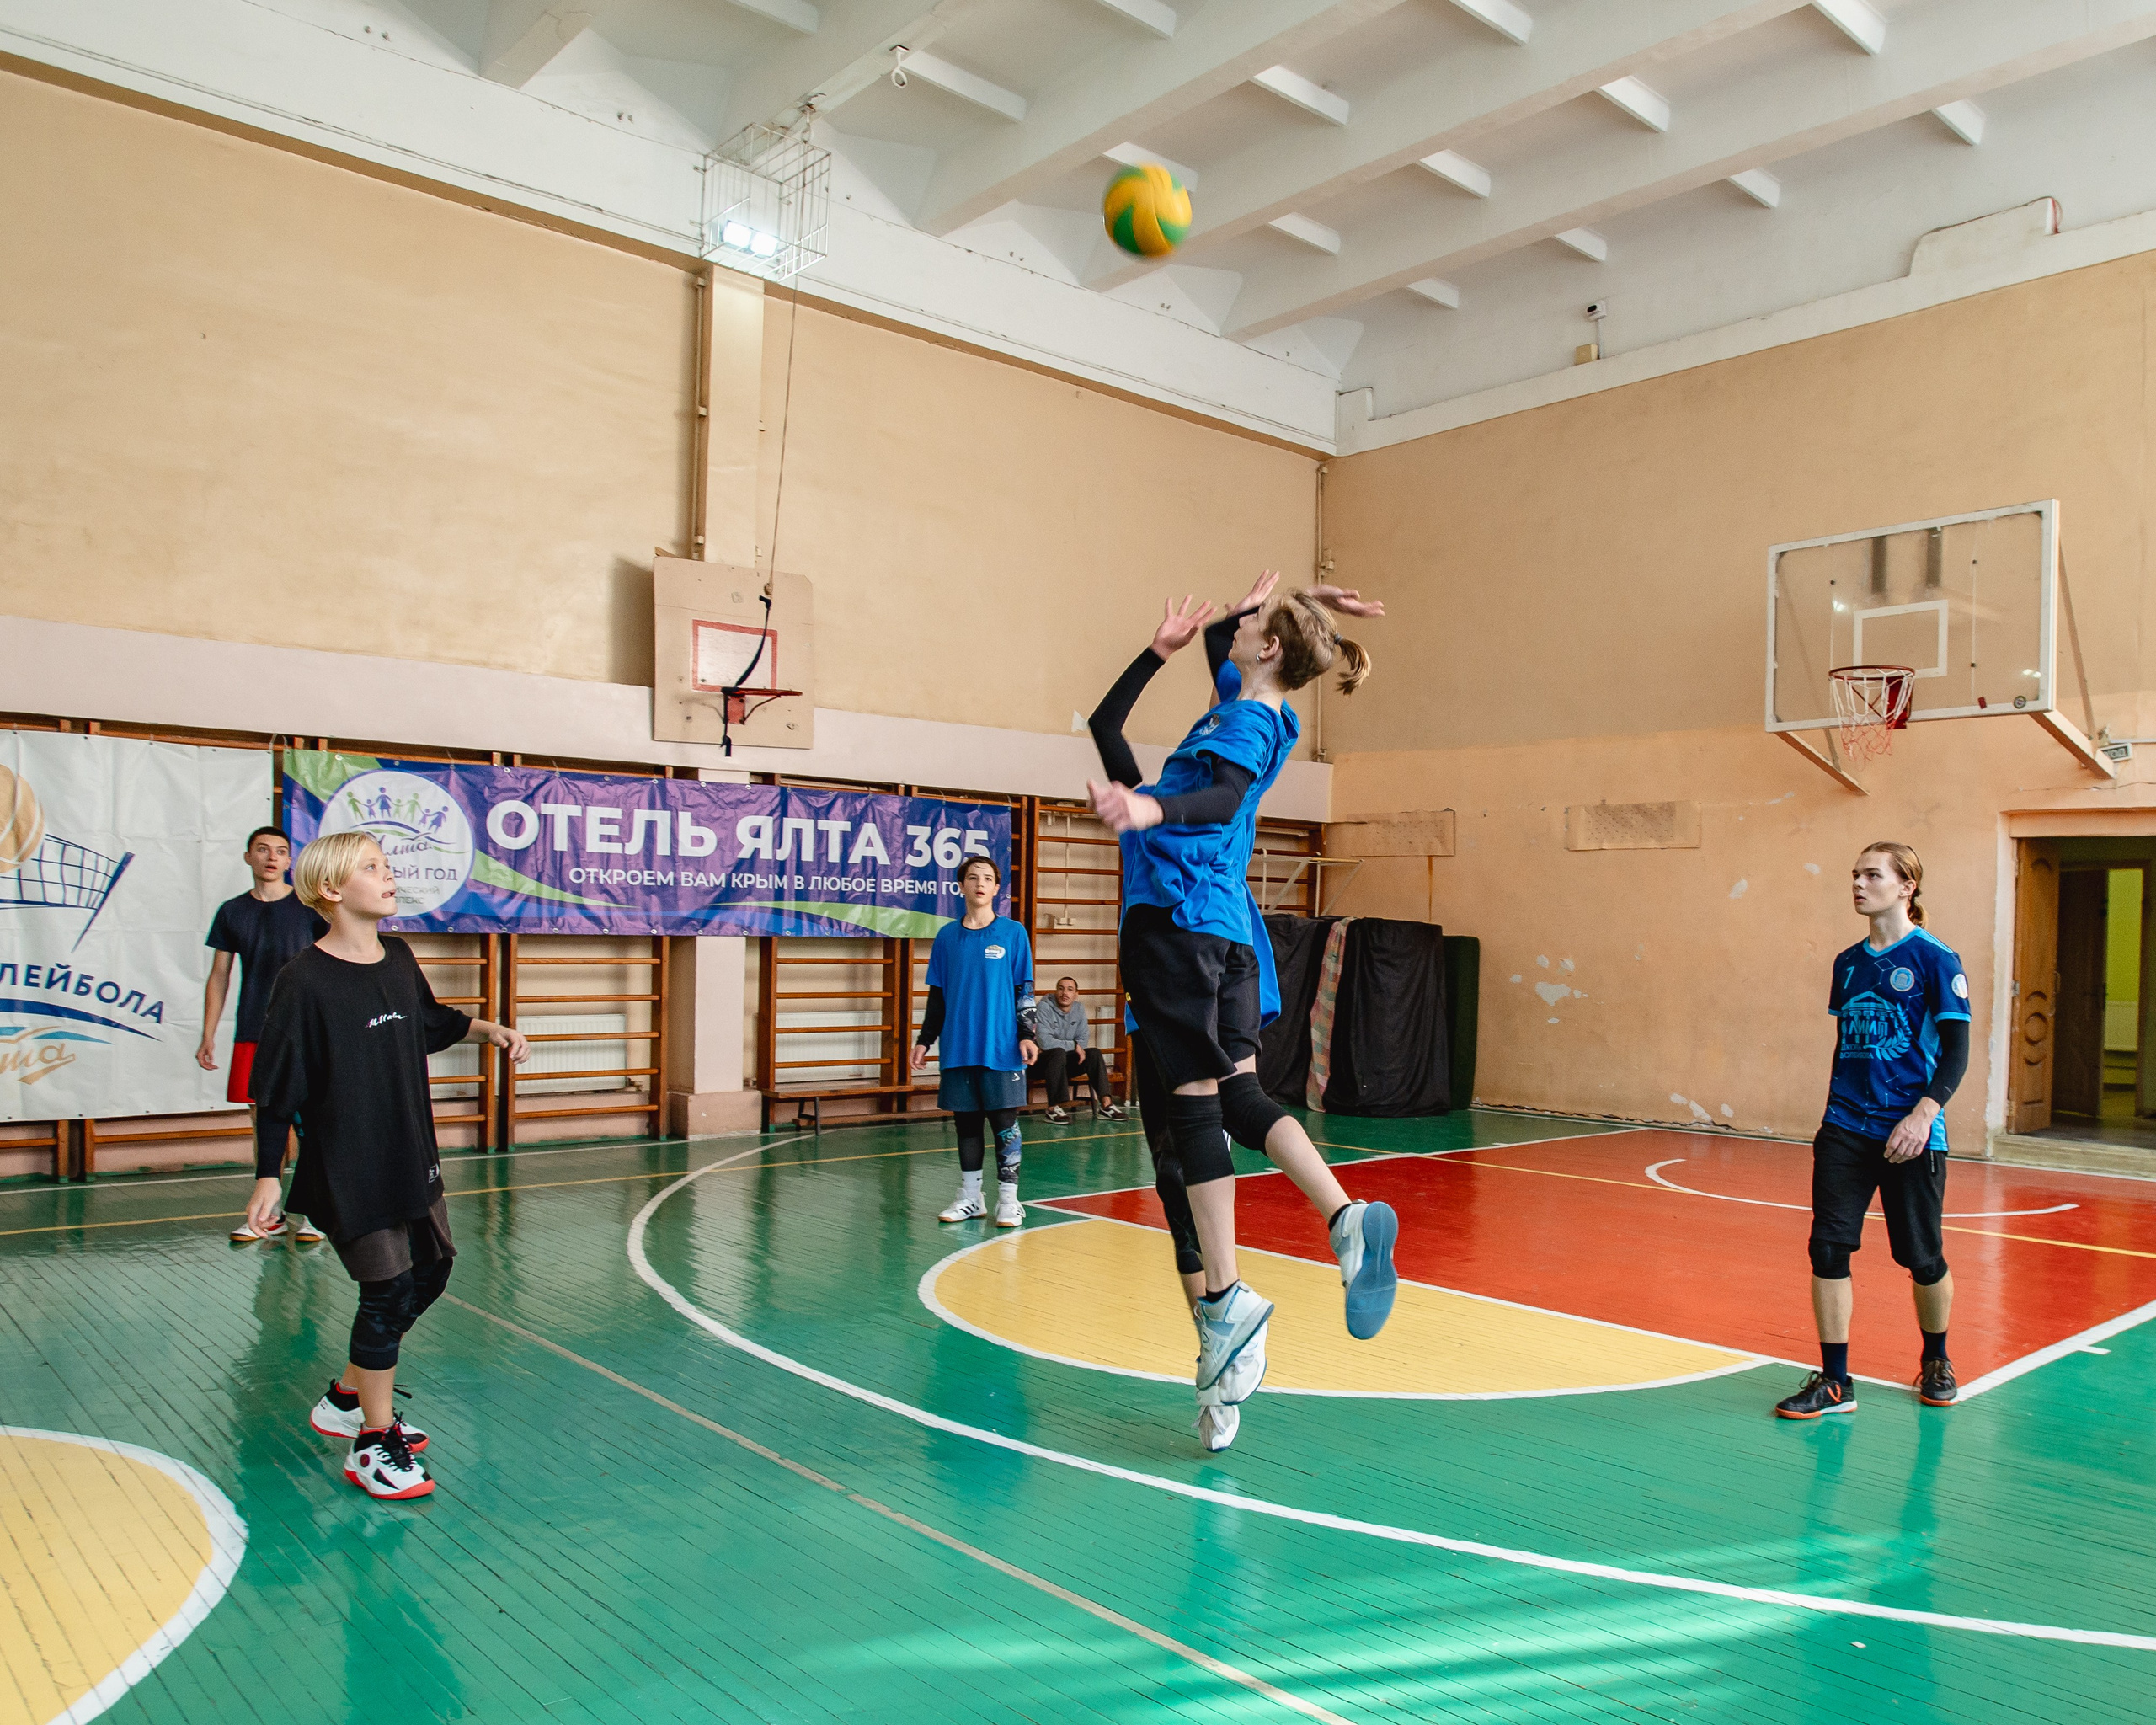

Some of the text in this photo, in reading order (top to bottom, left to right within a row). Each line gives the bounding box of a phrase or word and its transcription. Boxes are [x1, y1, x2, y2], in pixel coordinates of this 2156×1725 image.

[486, 799, 990, 869] ОТЕЛЬ ЯЛТА 365
[424, 868, 457, 881] ГОД
[568, 868, 674, 886] ОТКРОЕМ
[680, 872, 726, 888] ВАМ
[732, 873, 787, 889] КРЫМ
[794, 875, 805, 890] В
[808, 876, 876, 893] ЛЮБОЕ
[881, 879, 937, 895] ВРЕМЯ
[0, 962, 164, 1024] ЛЕЙБОЛА
